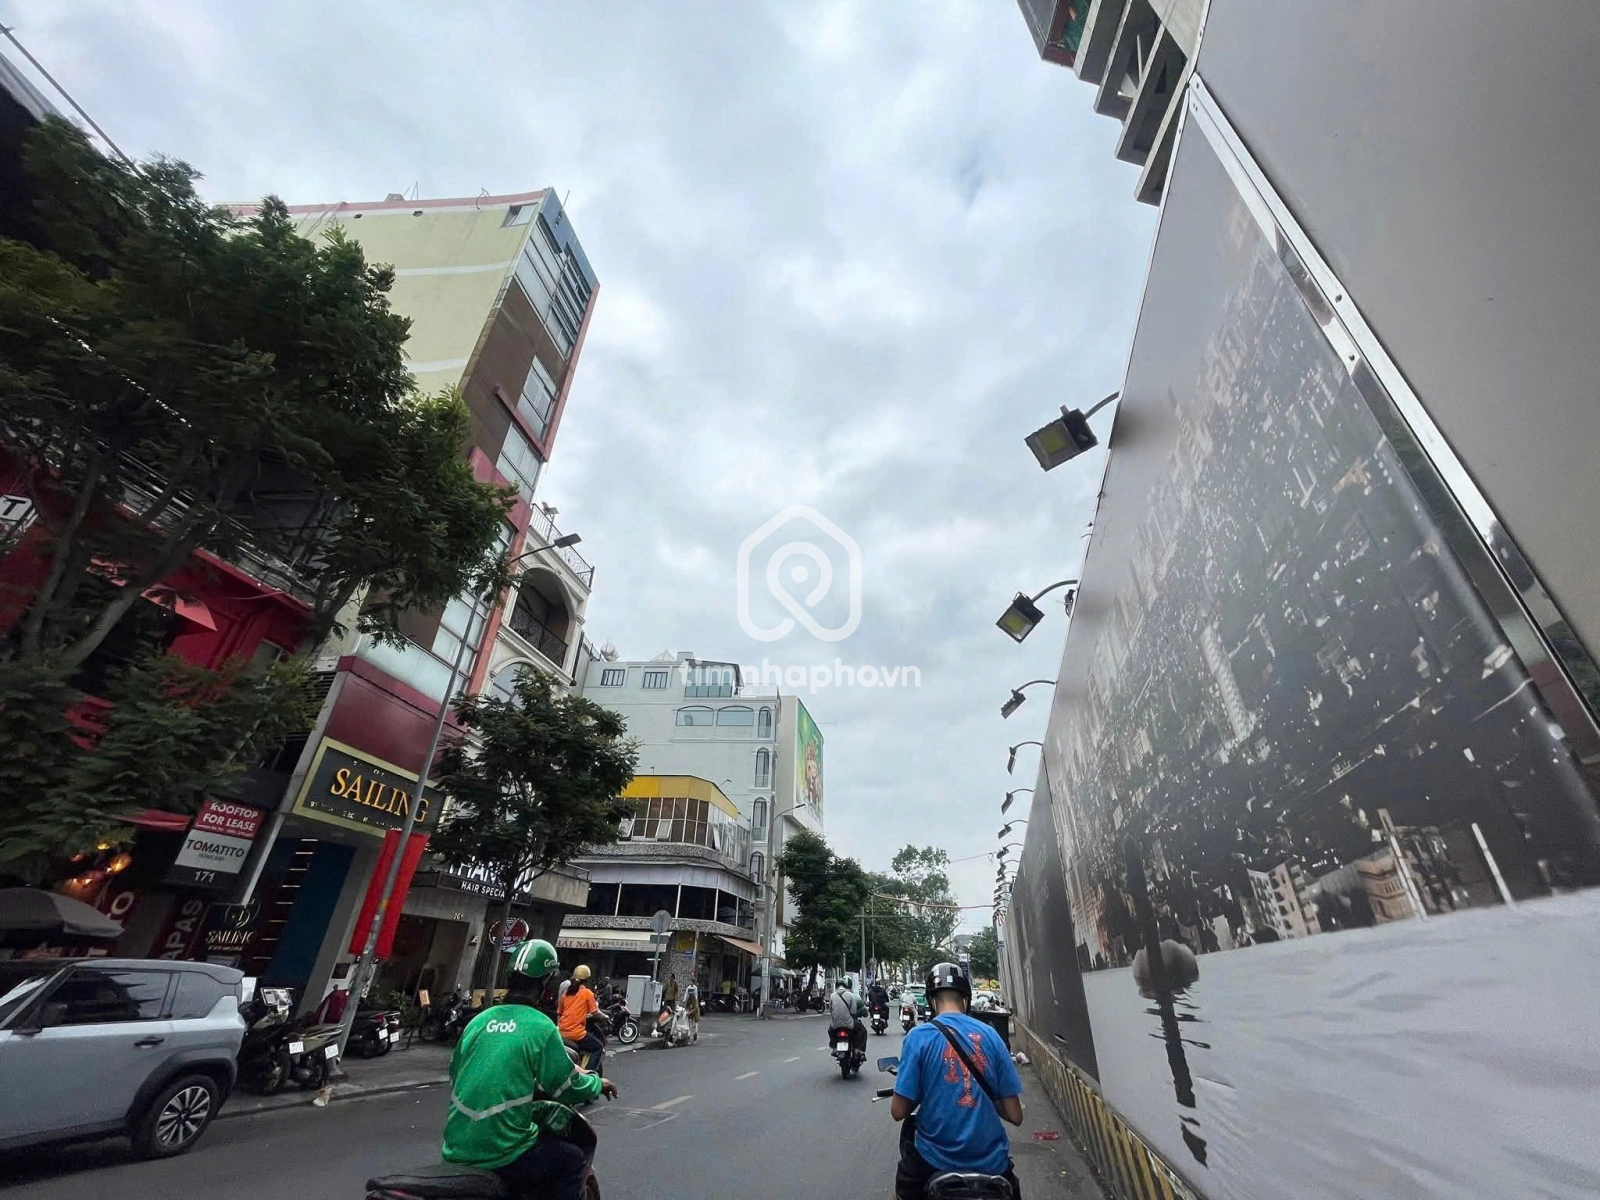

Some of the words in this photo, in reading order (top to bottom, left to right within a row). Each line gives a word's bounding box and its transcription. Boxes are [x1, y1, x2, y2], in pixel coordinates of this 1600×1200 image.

[330, 768, 430, 823] SAILING
[210, 801, 259, 819] ROOFTOP
[202, 813, 225, 825] FOR
[225, 817, 256, 831] LEASE
[187, 839, 245, 857] TOMATITO
[194, 870, 215, 883] 171
[461, 881, 480, 894] HAIR
[481, 885, 519, 901] SPECIAT
[486, 1018, 517, 1033] Grab
